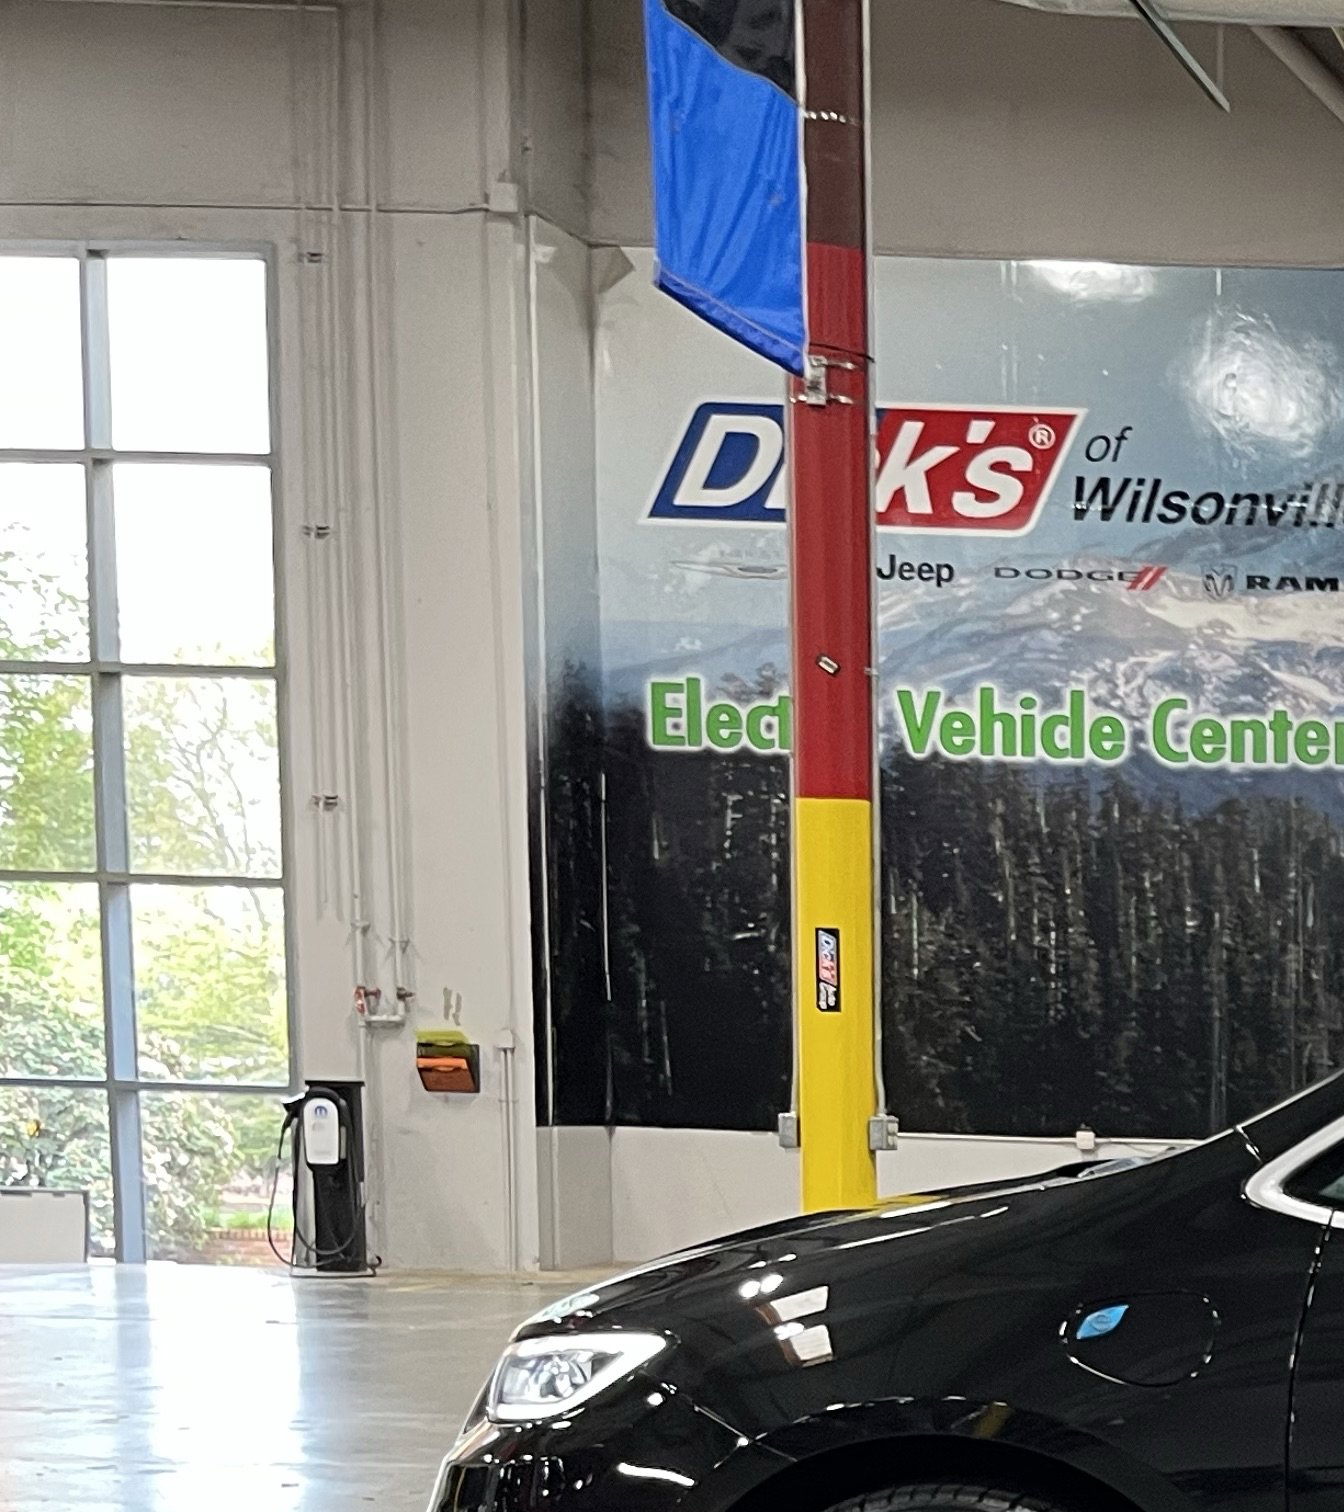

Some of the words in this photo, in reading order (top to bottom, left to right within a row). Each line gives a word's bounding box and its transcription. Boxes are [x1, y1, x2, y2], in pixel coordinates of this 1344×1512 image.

[1084, 426, 1133, 463] of
[672, 413, 1033, 519] Dk's
[876, 553, 955, 588] Jeep
[994, 566, 1141, 583] DODGE
[1246, 574, 1340, 592] RAM
[650, 676, 793, 751] Elect
[897, 686, 1126, 761] Vehicle
